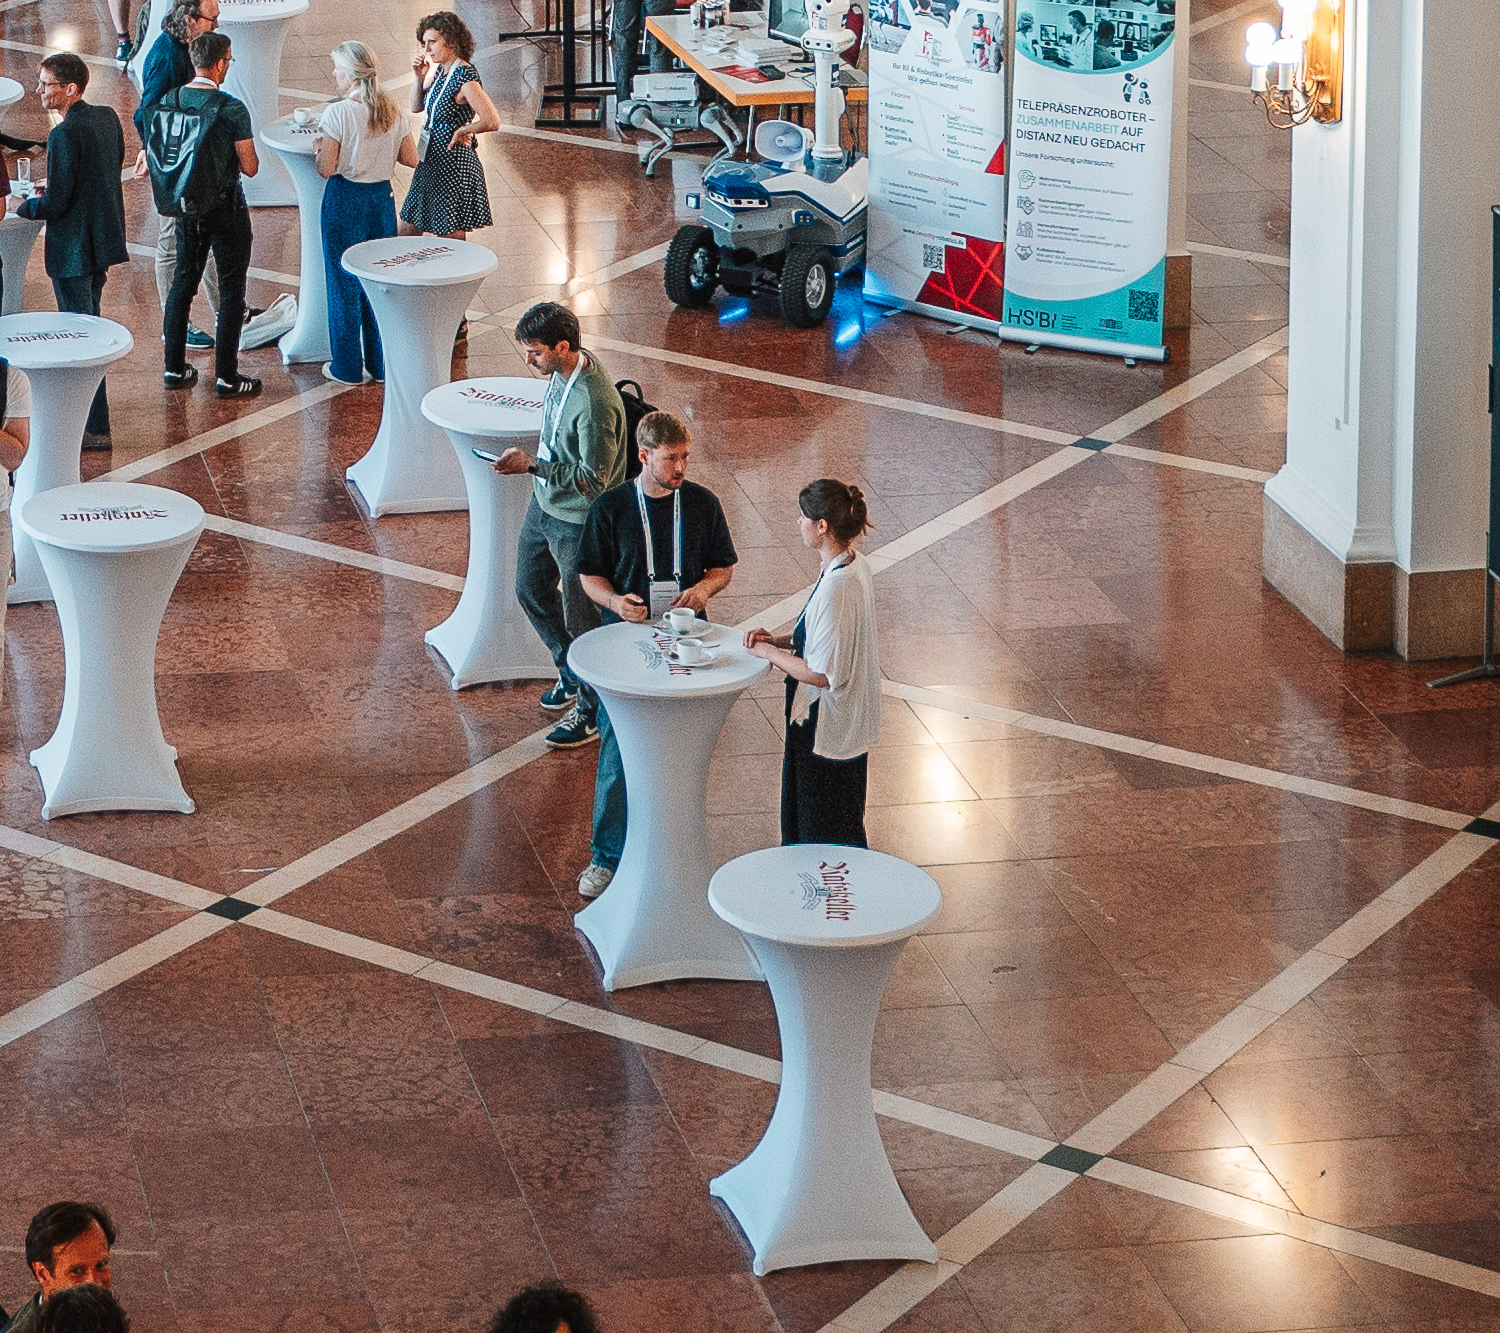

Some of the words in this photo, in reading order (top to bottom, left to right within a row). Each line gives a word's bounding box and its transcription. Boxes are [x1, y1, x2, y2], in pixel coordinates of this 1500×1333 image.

[1017, 99, 1147, 123] TELEPRÄSENZROBOTER
[1016, 114, 1119, 134] ZUSAMMENARBEIT
[1121, 126, 1144, 137] AUF
[1016, 129, 1062, 143] DISTANZ
[1064, 135, 1088, 146] NEU
[1090, 137, 1146, 153] GEDACHT
[1016, 150, 1038, 159] Unsere
[1040, 152, 1076, 164] Forschung
[60, 509, 168, 521] Ratskeller
